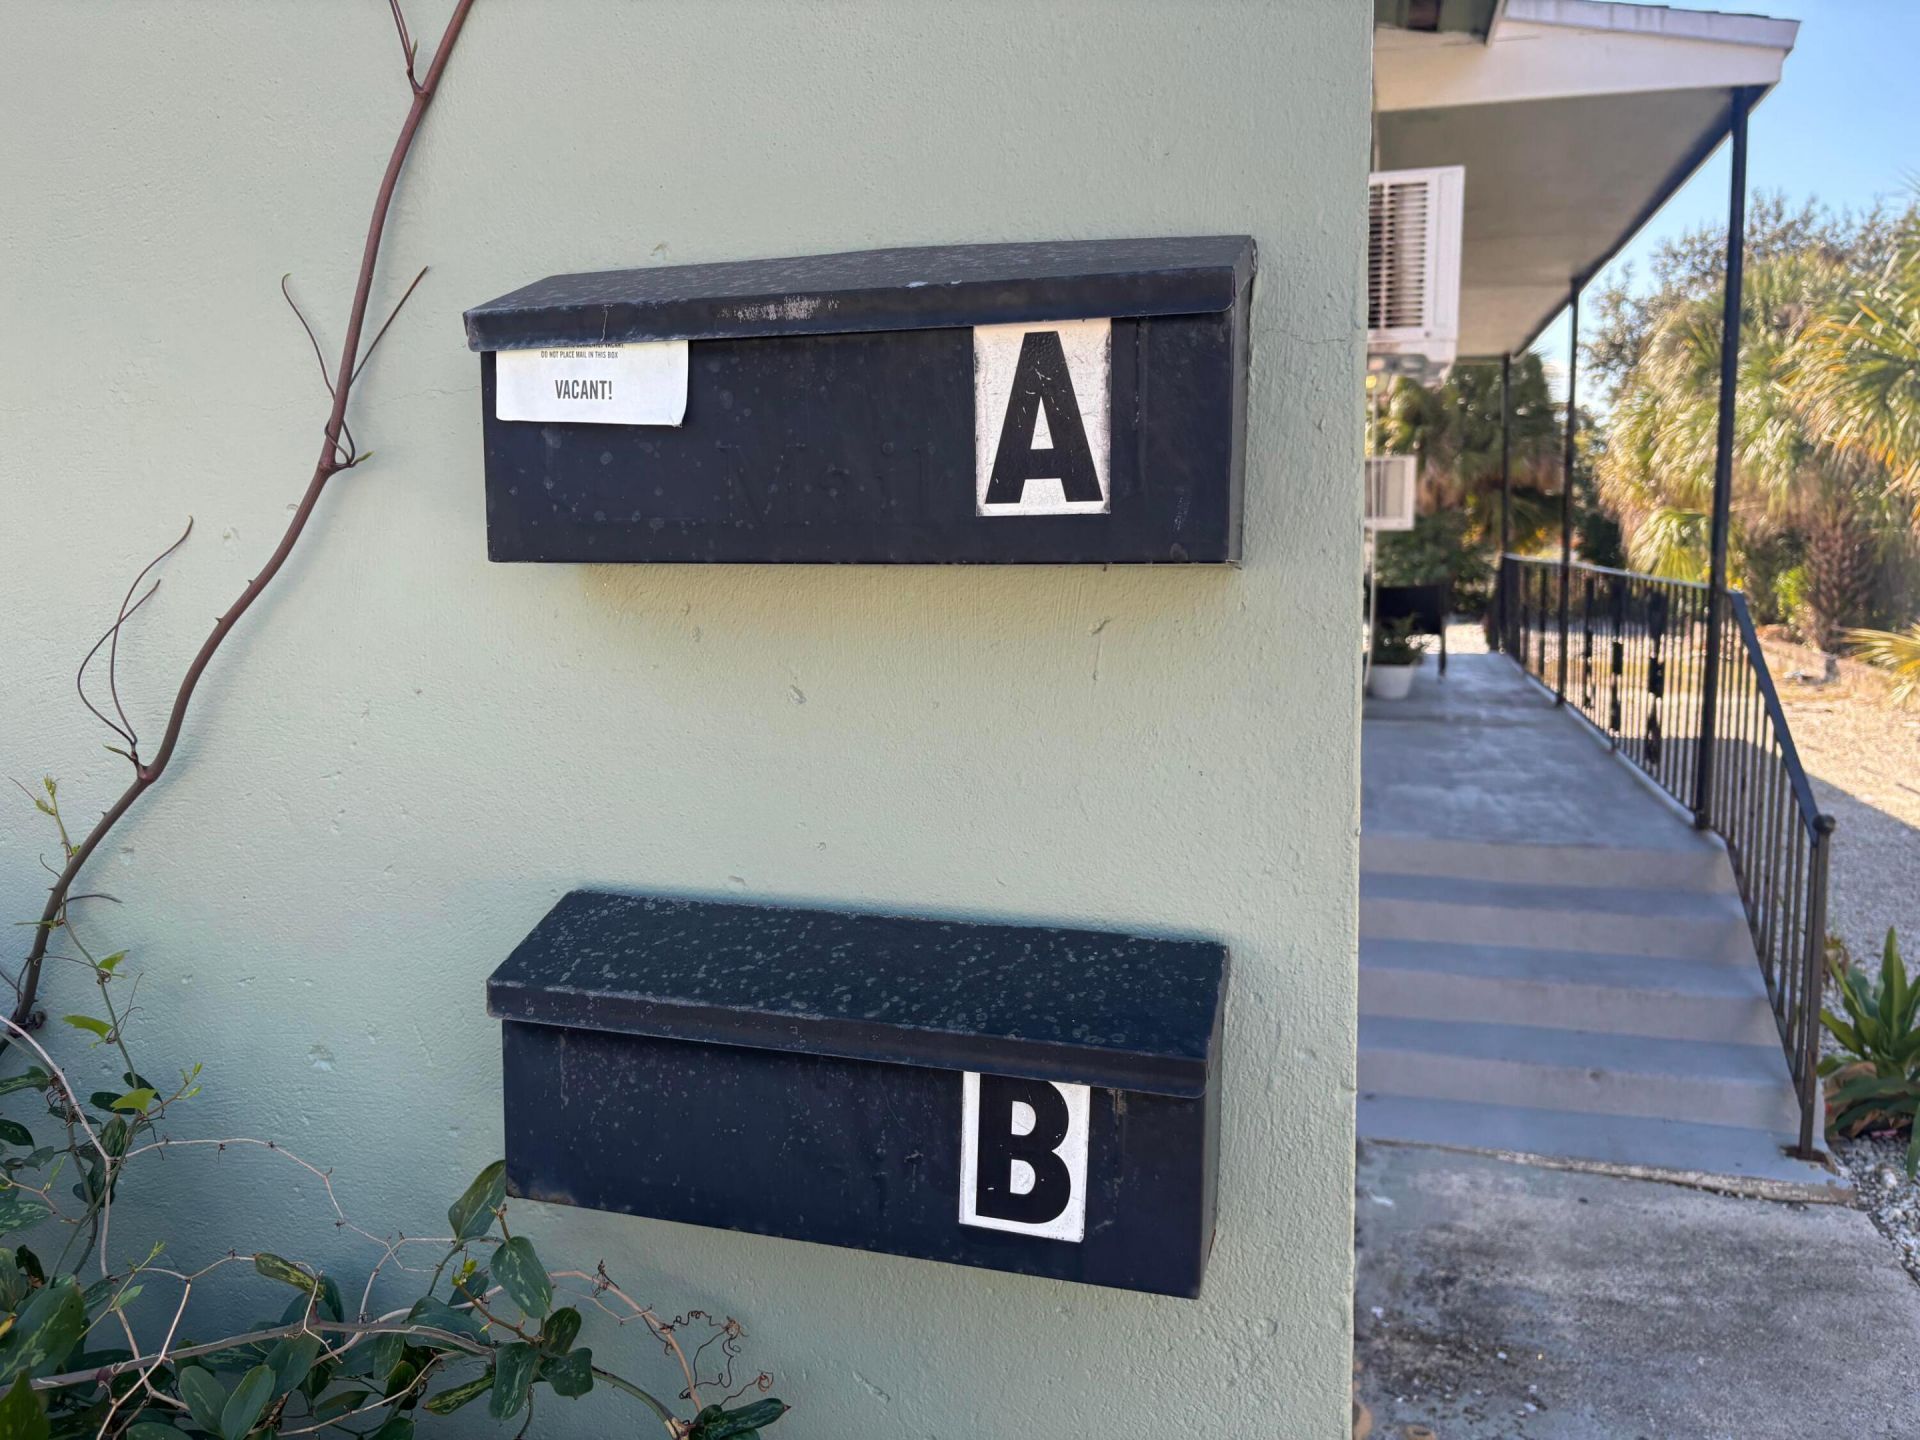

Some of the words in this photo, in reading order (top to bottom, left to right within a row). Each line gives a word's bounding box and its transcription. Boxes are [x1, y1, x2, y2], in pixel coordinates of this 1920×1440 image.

[541, 350, 549, 359] DO
[549, 350, 559, 359] NOT
[559, 350, 575, 359] PLACE
[576, 350, 587, 359] MAIL
[595, 350, 607, 359] THIS
[608, 350, 619, 359] BOX
[555, 379, 612, 400] VACANT!
[985, 331, 1104, 504] A
[975, 1073, 1072, 1224] B
